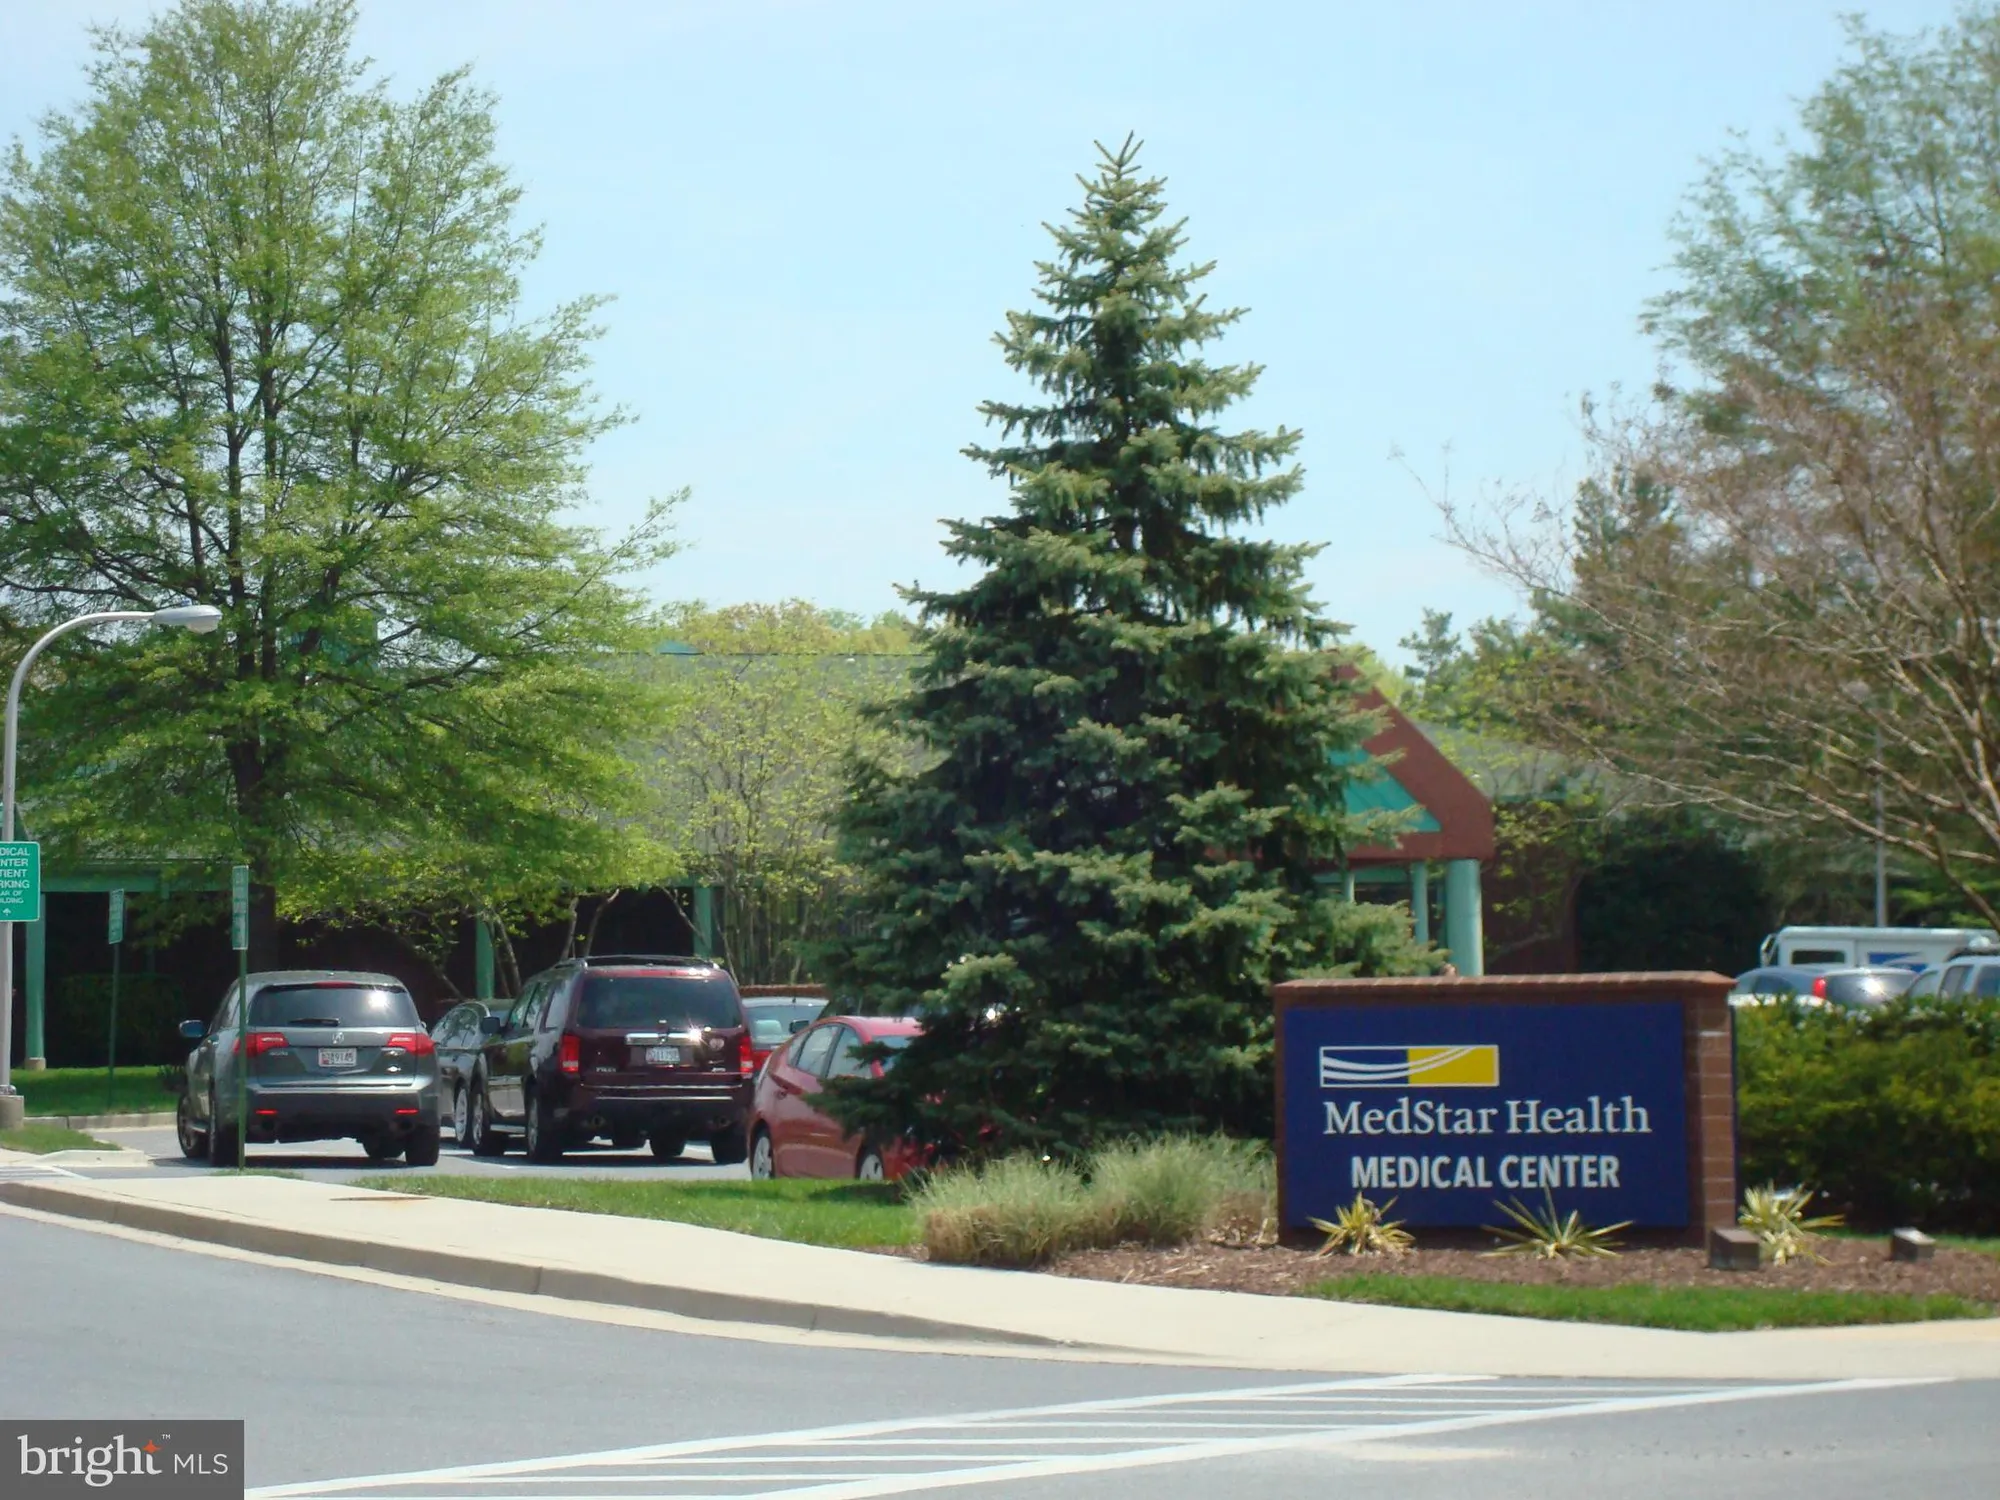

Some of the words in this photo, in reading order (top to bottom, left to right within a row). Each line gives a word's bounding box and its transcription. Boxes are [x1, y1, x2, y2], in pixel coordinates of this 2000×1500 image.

[1322, 1096, 1499, 1135] MedStar
[1504, 1096, 1653, 1134] Health
[1351, 1155, 1493, 1189] MEDICAL
[1499, 1155, 1620, 1189] CENTER
